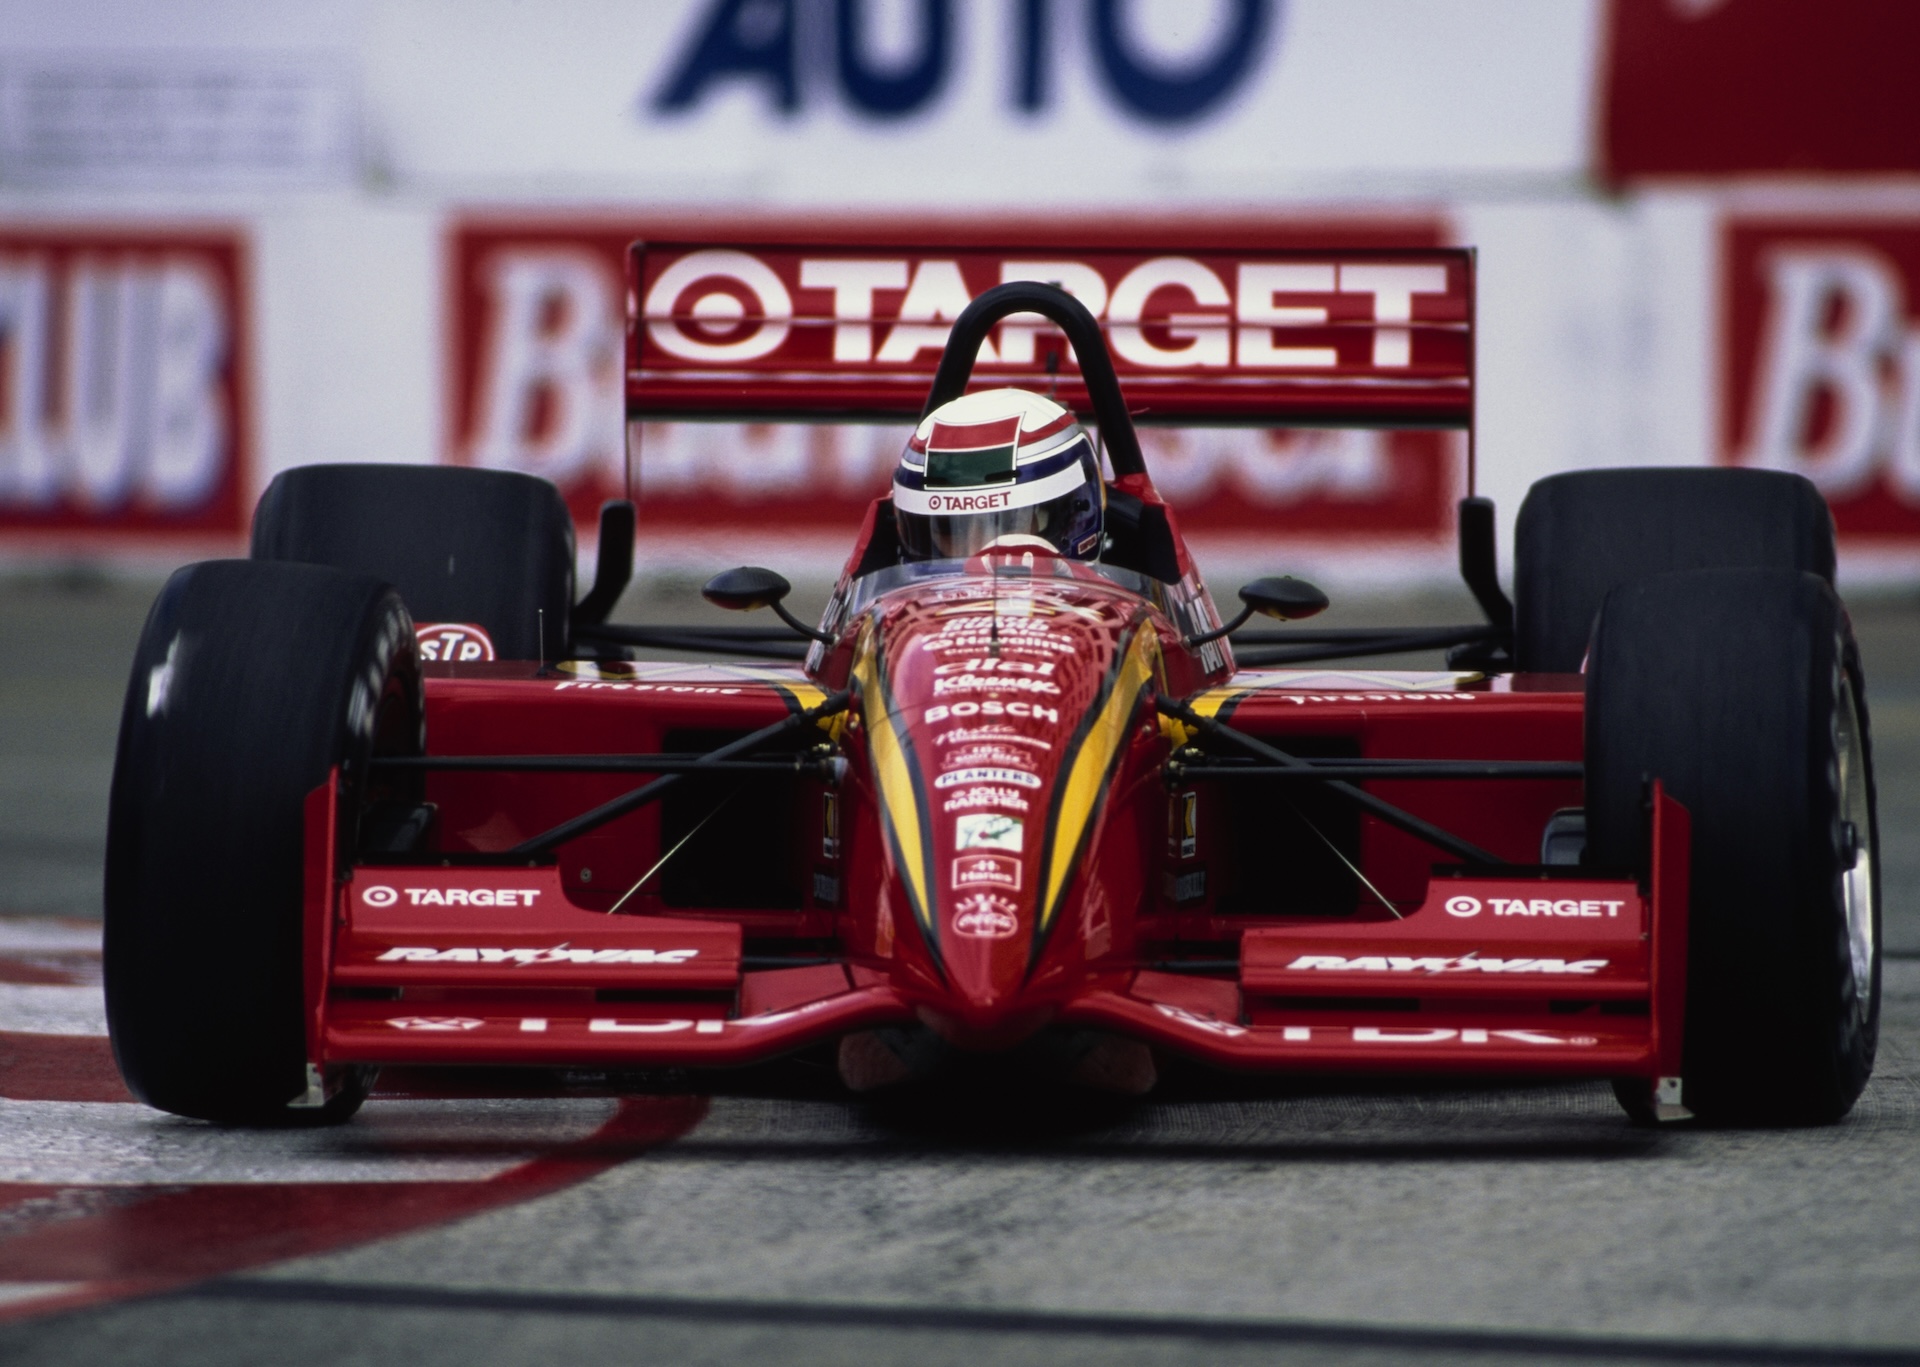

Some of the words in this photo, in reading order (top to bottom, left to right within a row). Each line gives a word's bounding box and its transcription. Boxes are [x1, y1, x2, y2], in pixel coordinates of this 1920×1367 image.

[800, 258, 1447, 367] TARGET
[943, 491, 1011, 510] TARGET
[420, 632, 482, 661] STP
[925, 701, 1058, 724] BOSCH
[942, 770, 1035, 785] PLANTERS
[944, 796, 1029, 812] RANCHER
[404, 888, 541, 907] TARGET
[1487, 898, 1625, 917] TARGET
